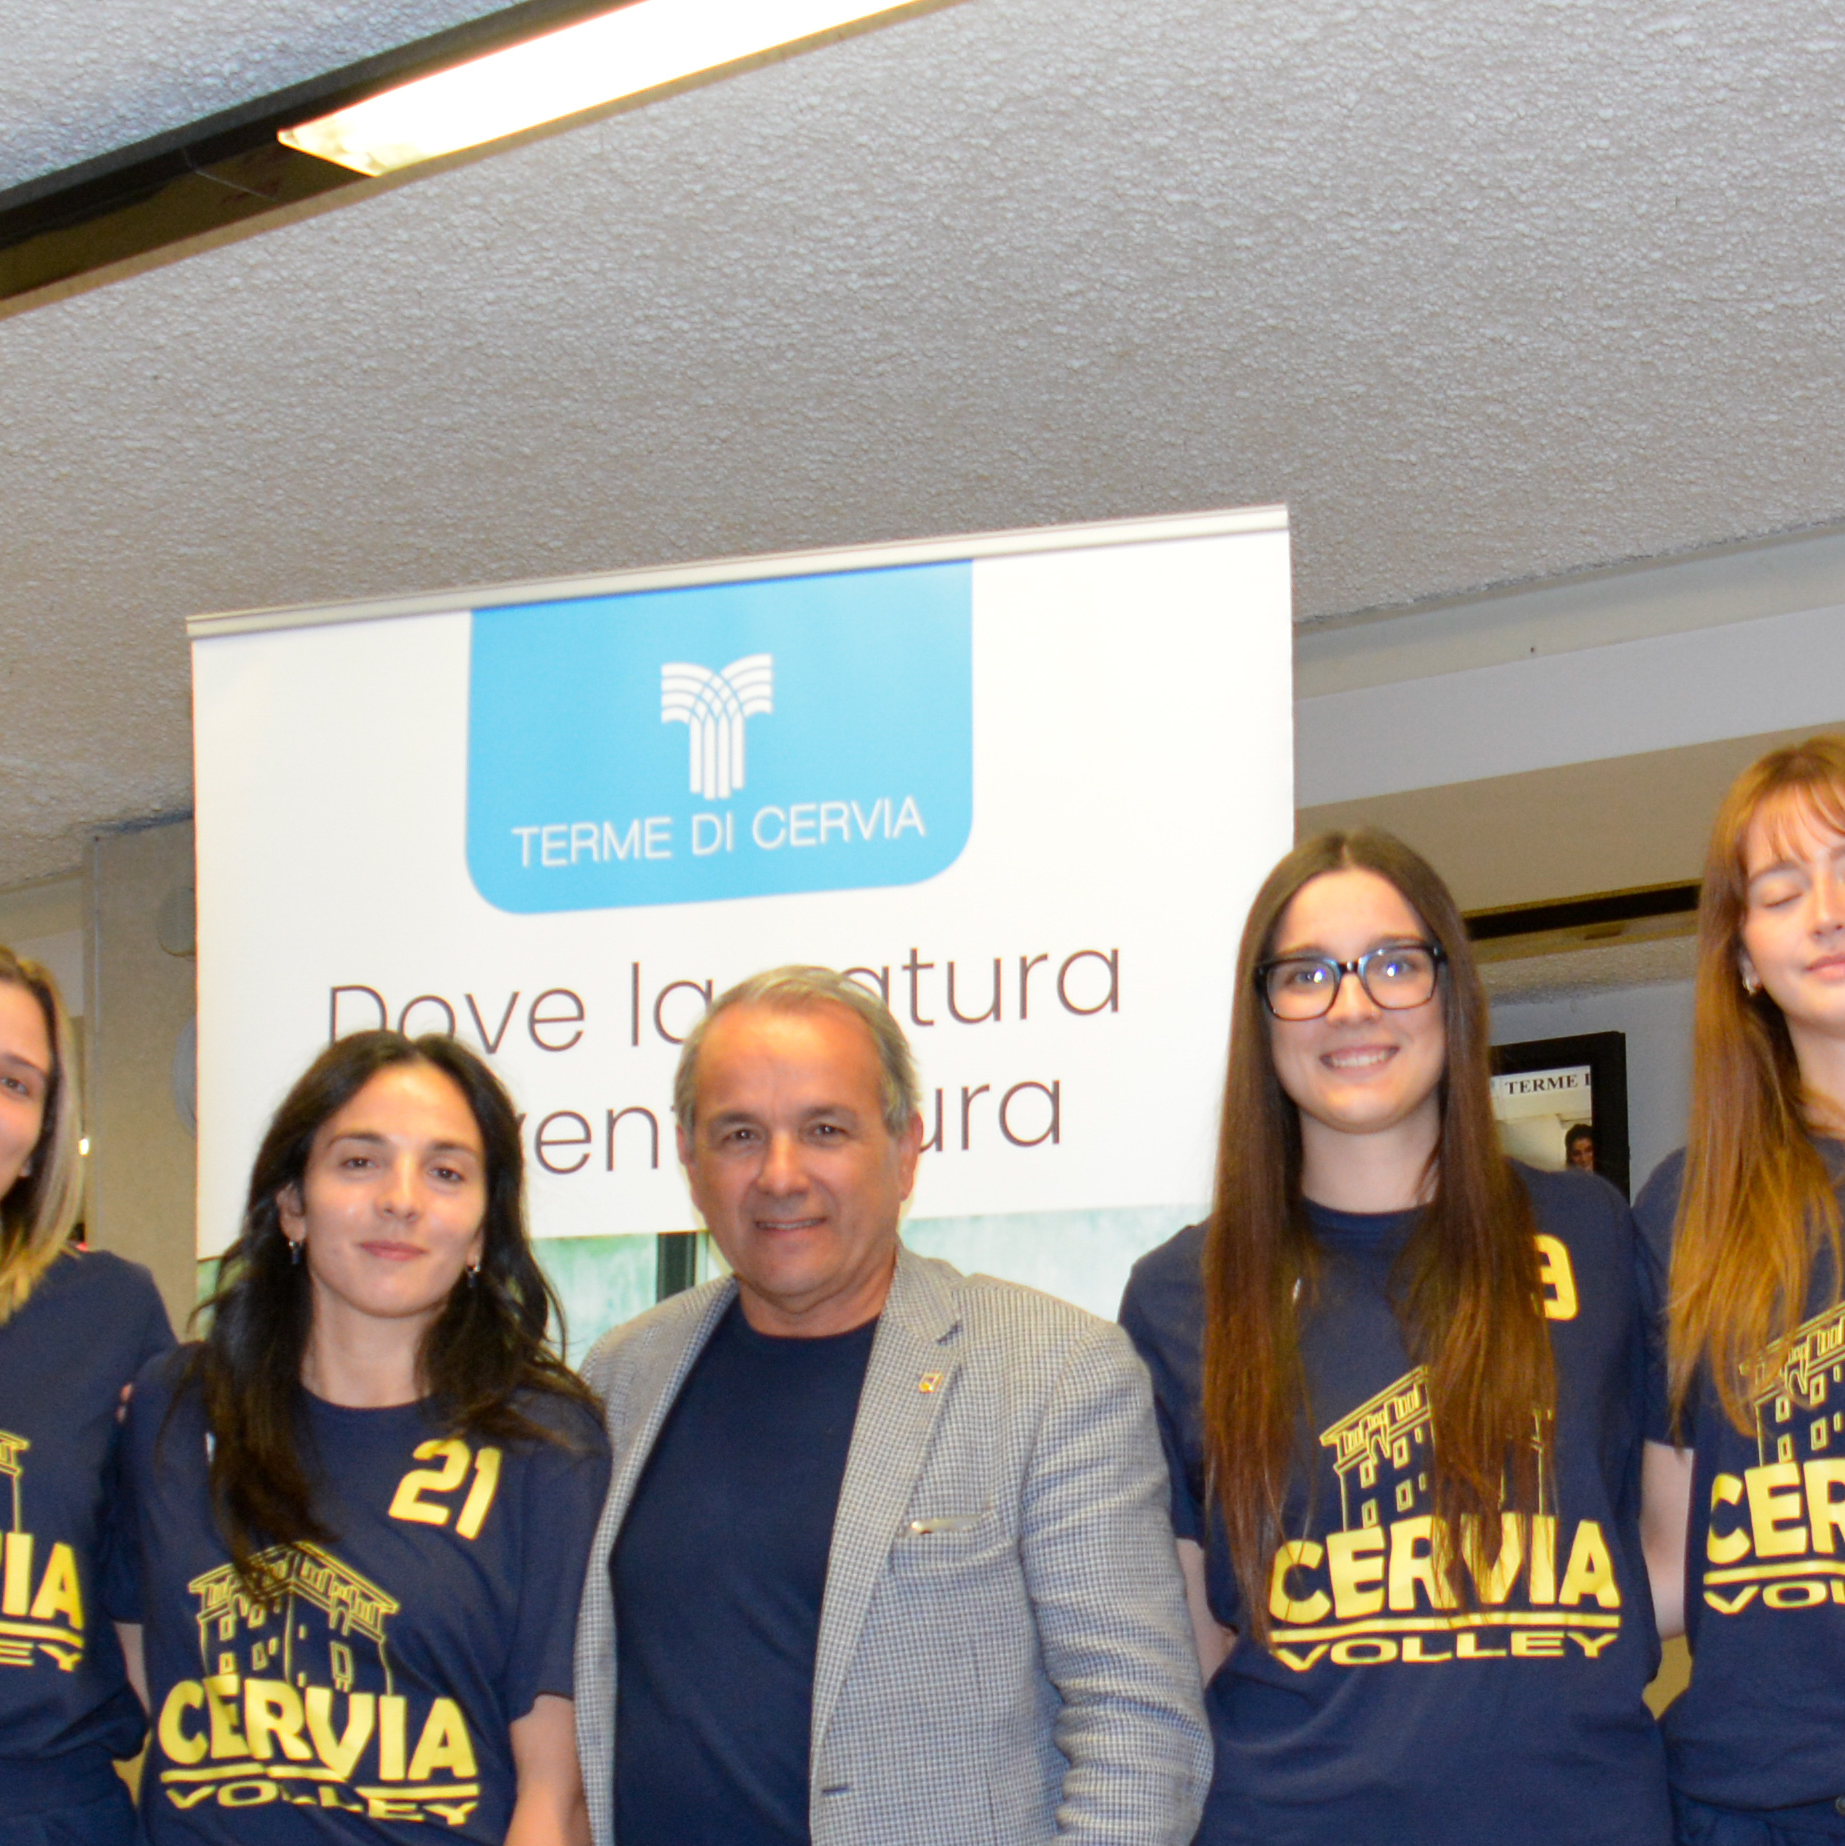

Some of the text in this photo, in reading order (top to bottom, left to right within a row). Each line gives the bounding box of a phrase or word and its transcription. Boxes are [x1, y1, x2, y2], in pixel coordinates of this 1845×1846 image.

[512, 796, 926, 868] TERME DI CERVIA
[328, 983, 587, 1055] Dove
[1504, 1074, 1579, 1095] TERME
[387, 1437, 503, 1541] 21
[1267, 1511, 1623, 1625] CERVIA
[1269, 1630, 1619, 1671] VOLLEY
[157, 1674, 480, 1783] CERVIA
